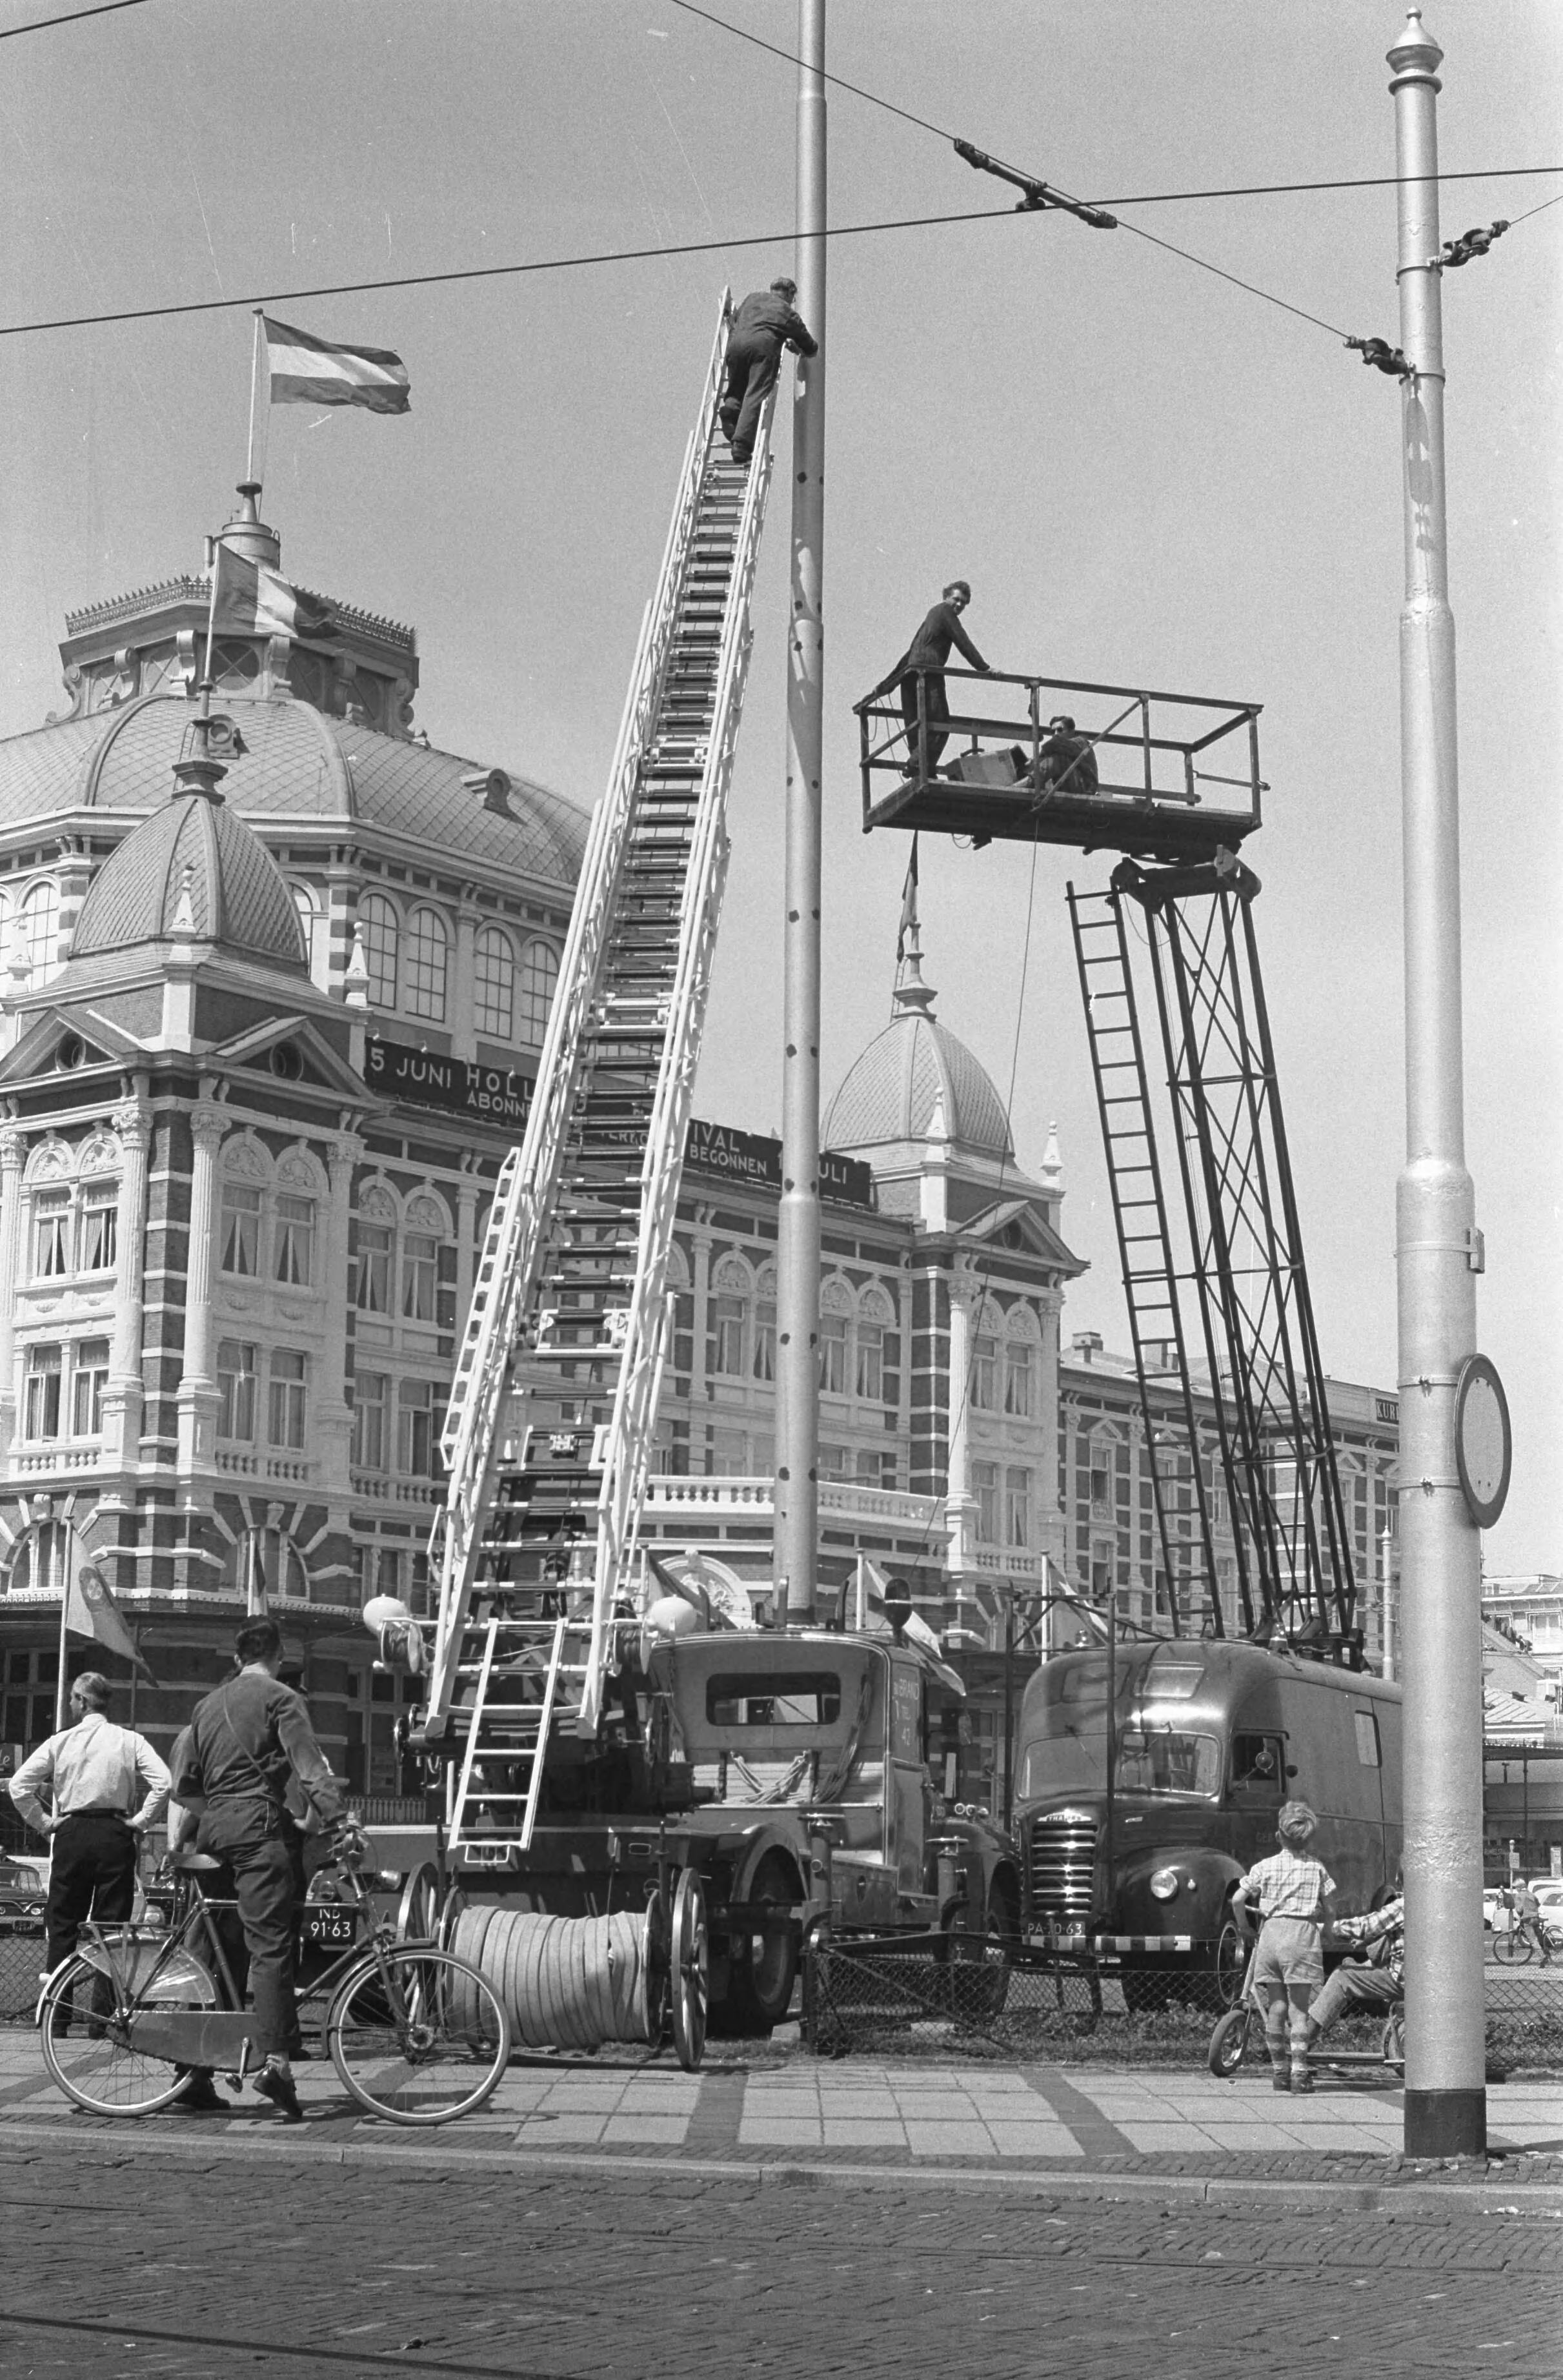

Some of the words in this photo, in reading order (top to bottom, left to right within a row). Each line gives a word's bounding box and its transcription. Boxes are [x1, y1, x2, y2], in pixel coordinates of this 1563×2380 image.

[370, 1047, 385, 1071] 5
[396, 1058, 451, 1089] JUNI
[818, 1160, 847, 1185] ULI
[690, 1143, 767, 1176] BEGONNEN
